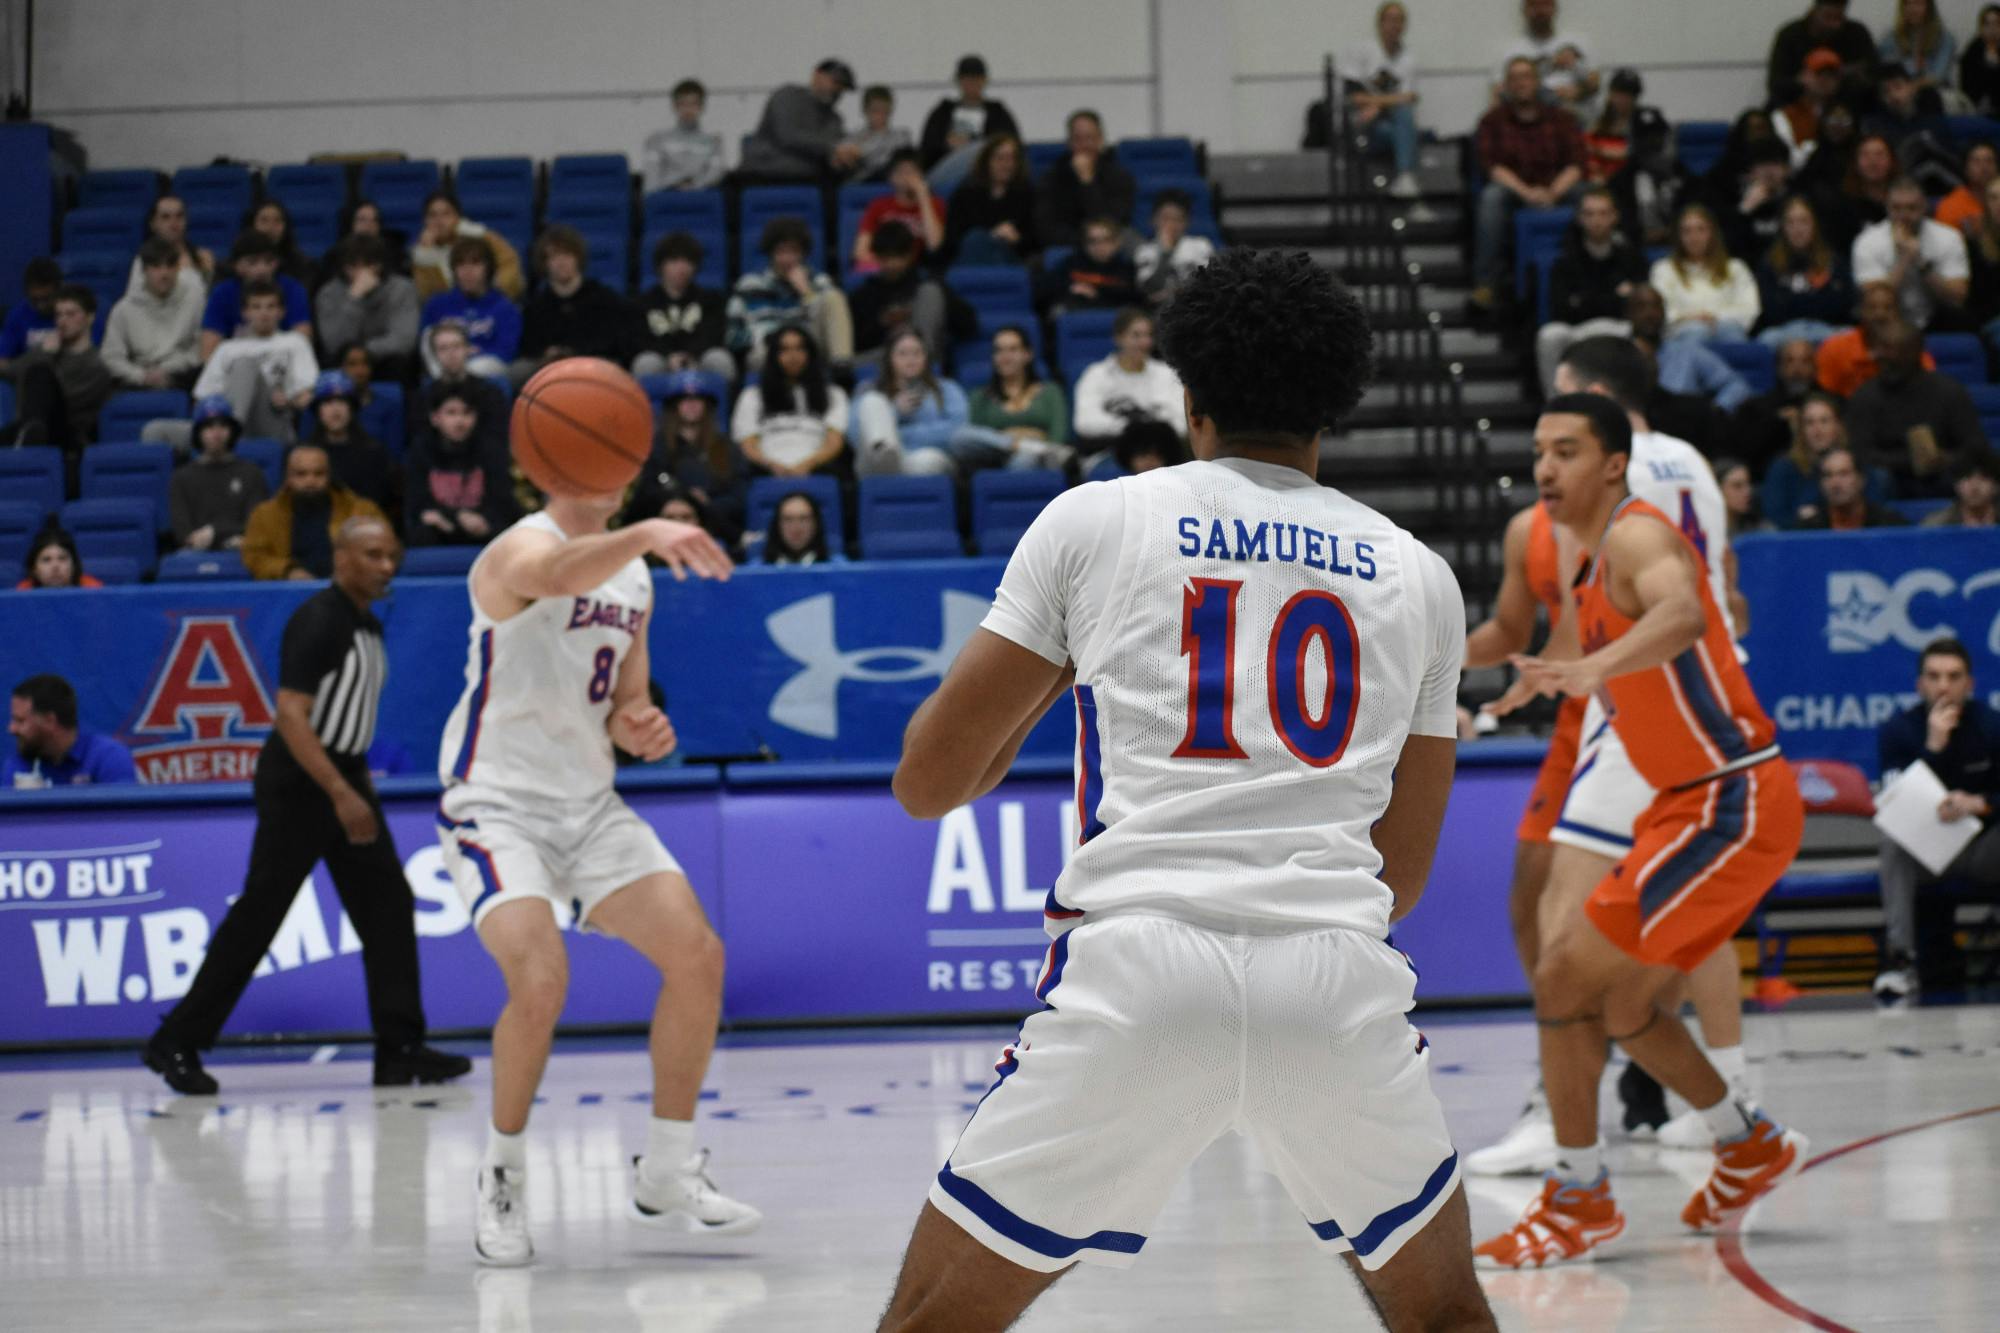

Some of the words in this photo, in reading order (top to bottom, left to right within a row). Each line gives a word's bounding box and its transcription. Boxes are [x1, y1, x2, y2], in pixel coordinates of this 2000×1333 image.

[1179, 516, 1377, 581] SAMUELS
[567, 597, 645, 636] EAGLE
[588, 644, 616, 704] 8
[1170, 576, 1361, 768] 10
[135, 749, 259, 786] MERI
[0, 859, 55, 899] HO
[67, 853, 153, 899] BUT
[927, 960, 1044, 991] REST
